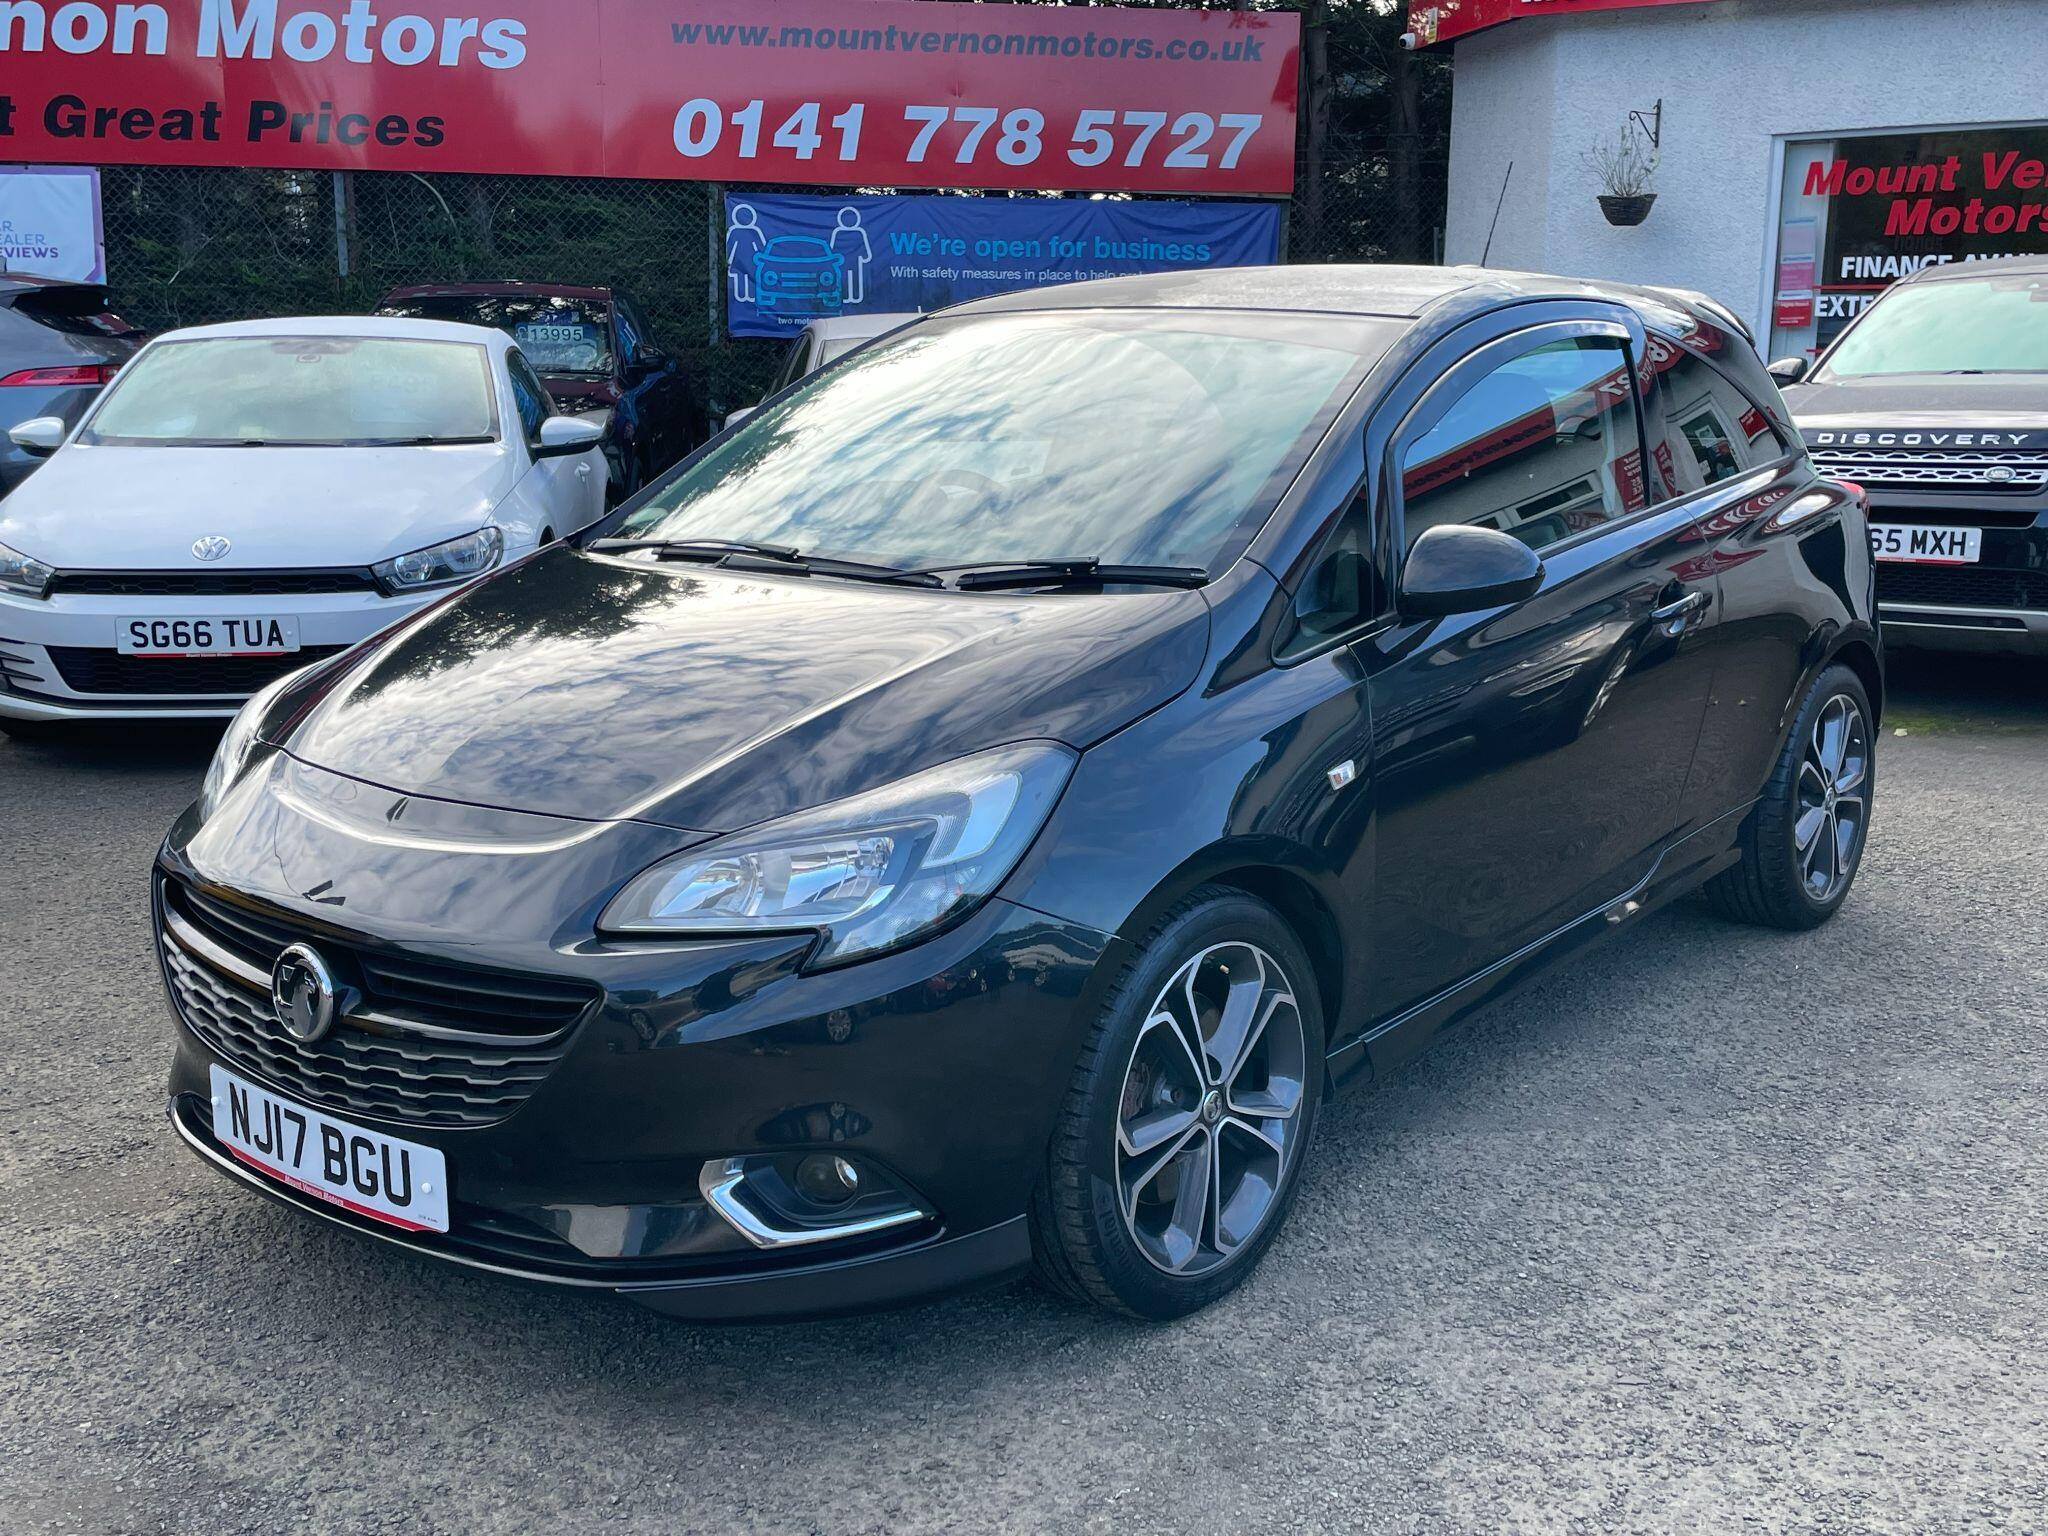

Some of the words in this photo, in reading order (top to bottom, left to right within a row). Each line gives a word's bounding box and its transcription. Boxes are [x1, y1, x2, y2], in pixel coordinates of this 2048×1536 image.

[196, 0, 527, 70] Motors
[671, 22, 1265, 62] www.mountvernonmotors.co.uk
[43, 94, 222, 141] Great
[247, 100, 445, 147] Prices
[673, 98, 865, 161] 0141
[904, 105, 1045, 167] 778
[1067, 109, 1264, 170] 5727
[1803, 156, 1961, 196] Mount
[1982, 150, 2048, 190] Ve
[0, 233, 47, 245] ALER
[974, 239, 1041, 262] open
[1049, 236, 1087, 258] for
[1094, 236, 1211, 262] business
[890, 266, 919, 278] With
[922, 267, 959, 281] safety
[962, 269, 1021, 280] measures
[1024, 269, 1035, 281] in
[1038, 269, 1072, 283] place
[1074, 270, 1087, 281] to
[1817, 433, 2029, 445] DISCOVERY
[1910, 530, 1967, 556] MXH
[130, 621, 213, 648] SG66
[222, 620, 285, 647] TUA
[229, 1081, 307, 1168] NJ17
[320, 1122, 412, 1207] BGU
